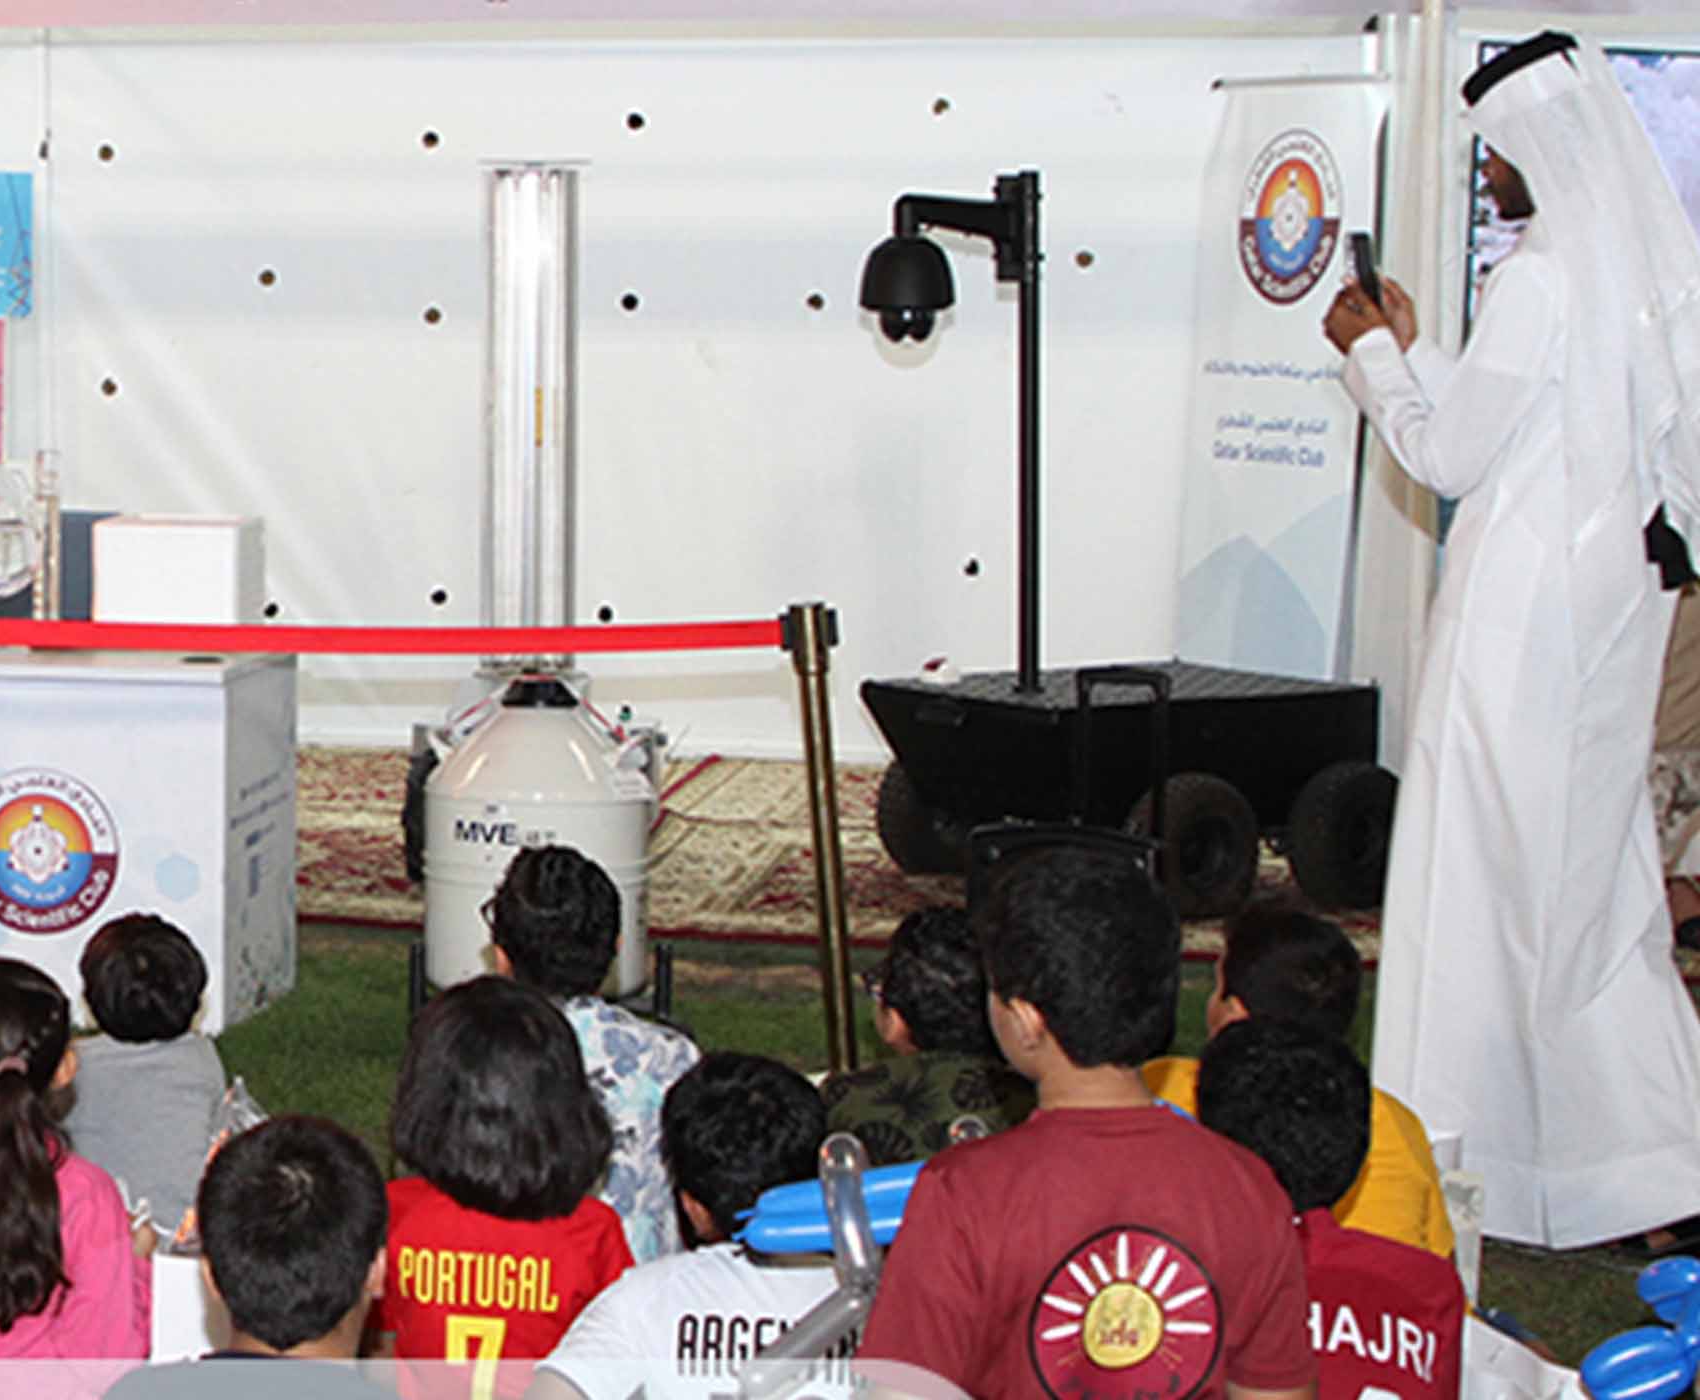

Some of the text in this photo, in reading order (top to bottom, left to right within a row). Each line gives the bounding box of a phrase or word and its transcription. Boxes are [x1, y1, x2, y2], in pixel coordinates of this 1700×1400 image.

[454, 819, 517, 846] MVE
[1, 902, 84, 929] Scientific
[77, 869, 110, 909] Club
[398, 1247, 560, 1312] PORTUGAL
[445, 1314, 506, 1400] 7
